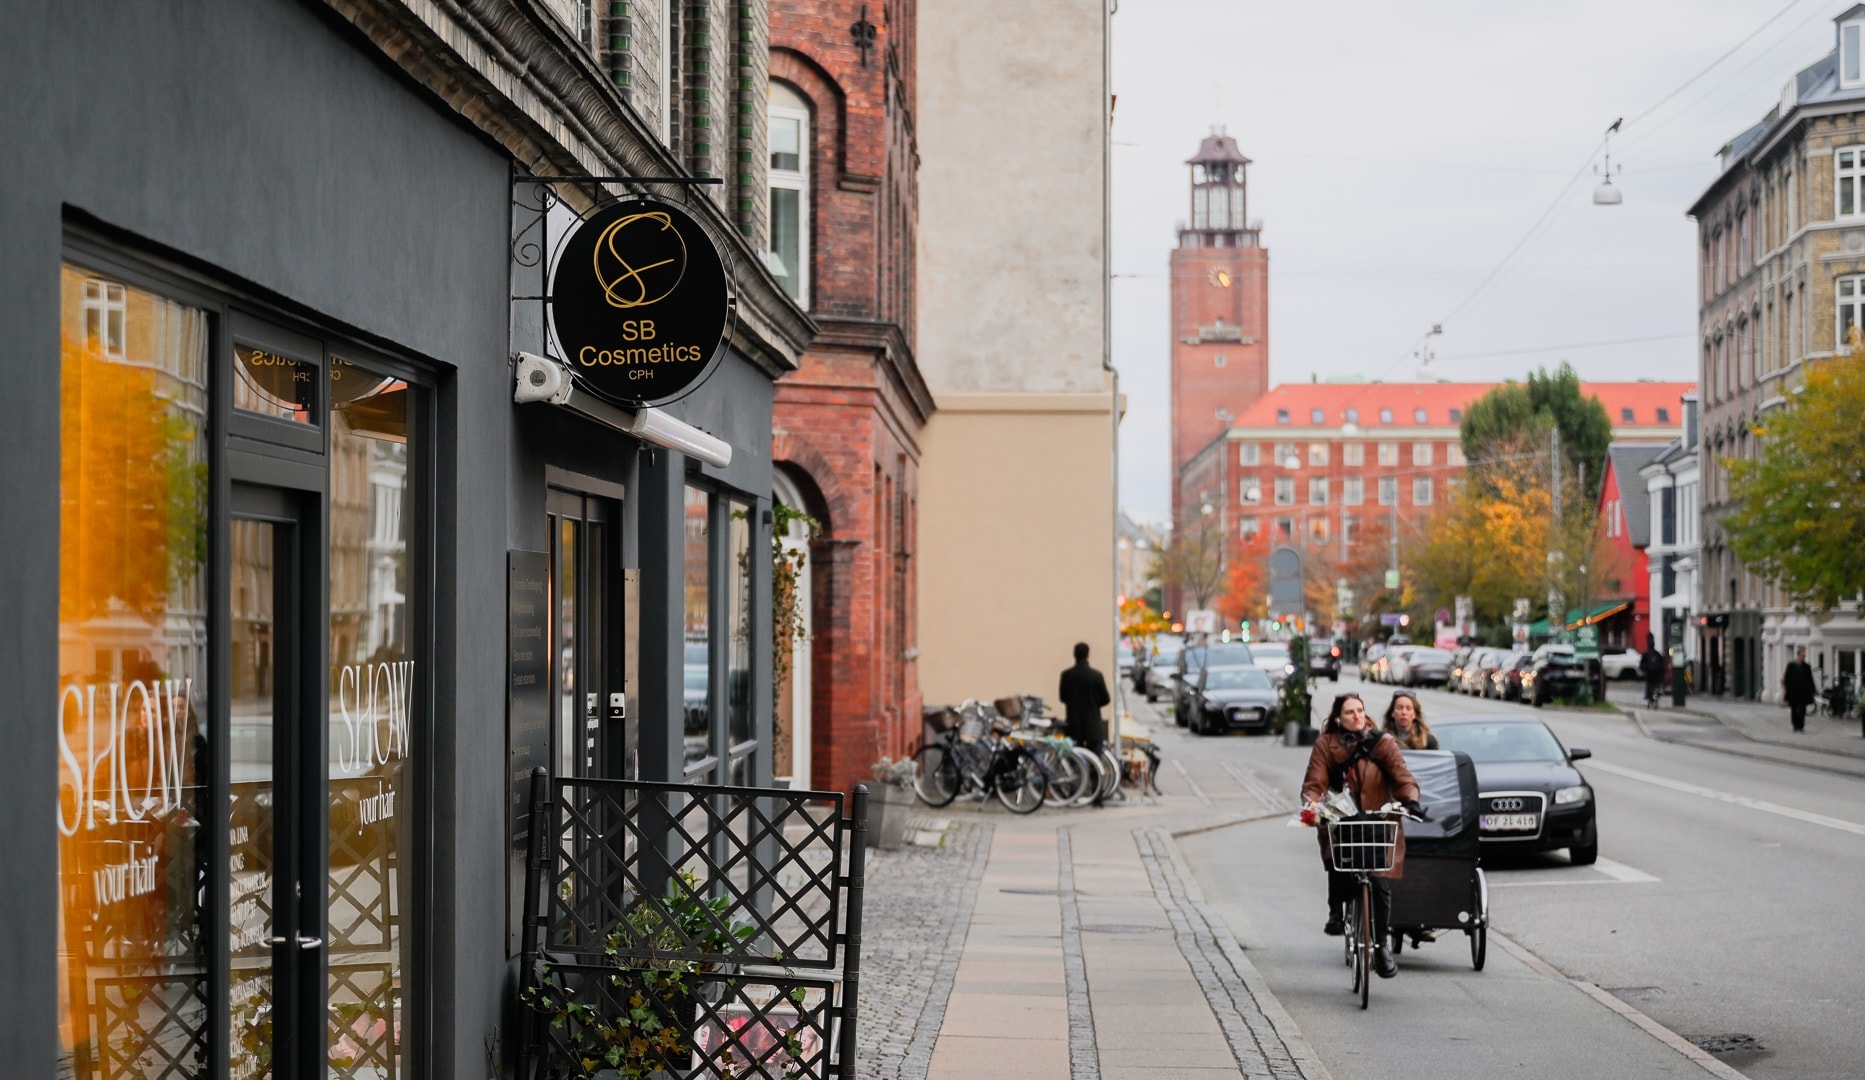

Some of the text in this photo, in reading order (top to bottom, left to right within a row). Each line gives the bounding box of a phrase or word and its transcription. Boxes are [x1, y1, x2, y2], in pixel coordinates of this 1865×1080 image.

[579, 342, 701, 367] Cosmetics
[622, 320, 656, 341] SB
[628, 369, 654, 380] CPH
[340, 661, 414, 773] SHOW
[57, 678, 192, 837] SHOW
[359, 780, 395, 836] your hair
[93, 843, 159, 921] your hair
